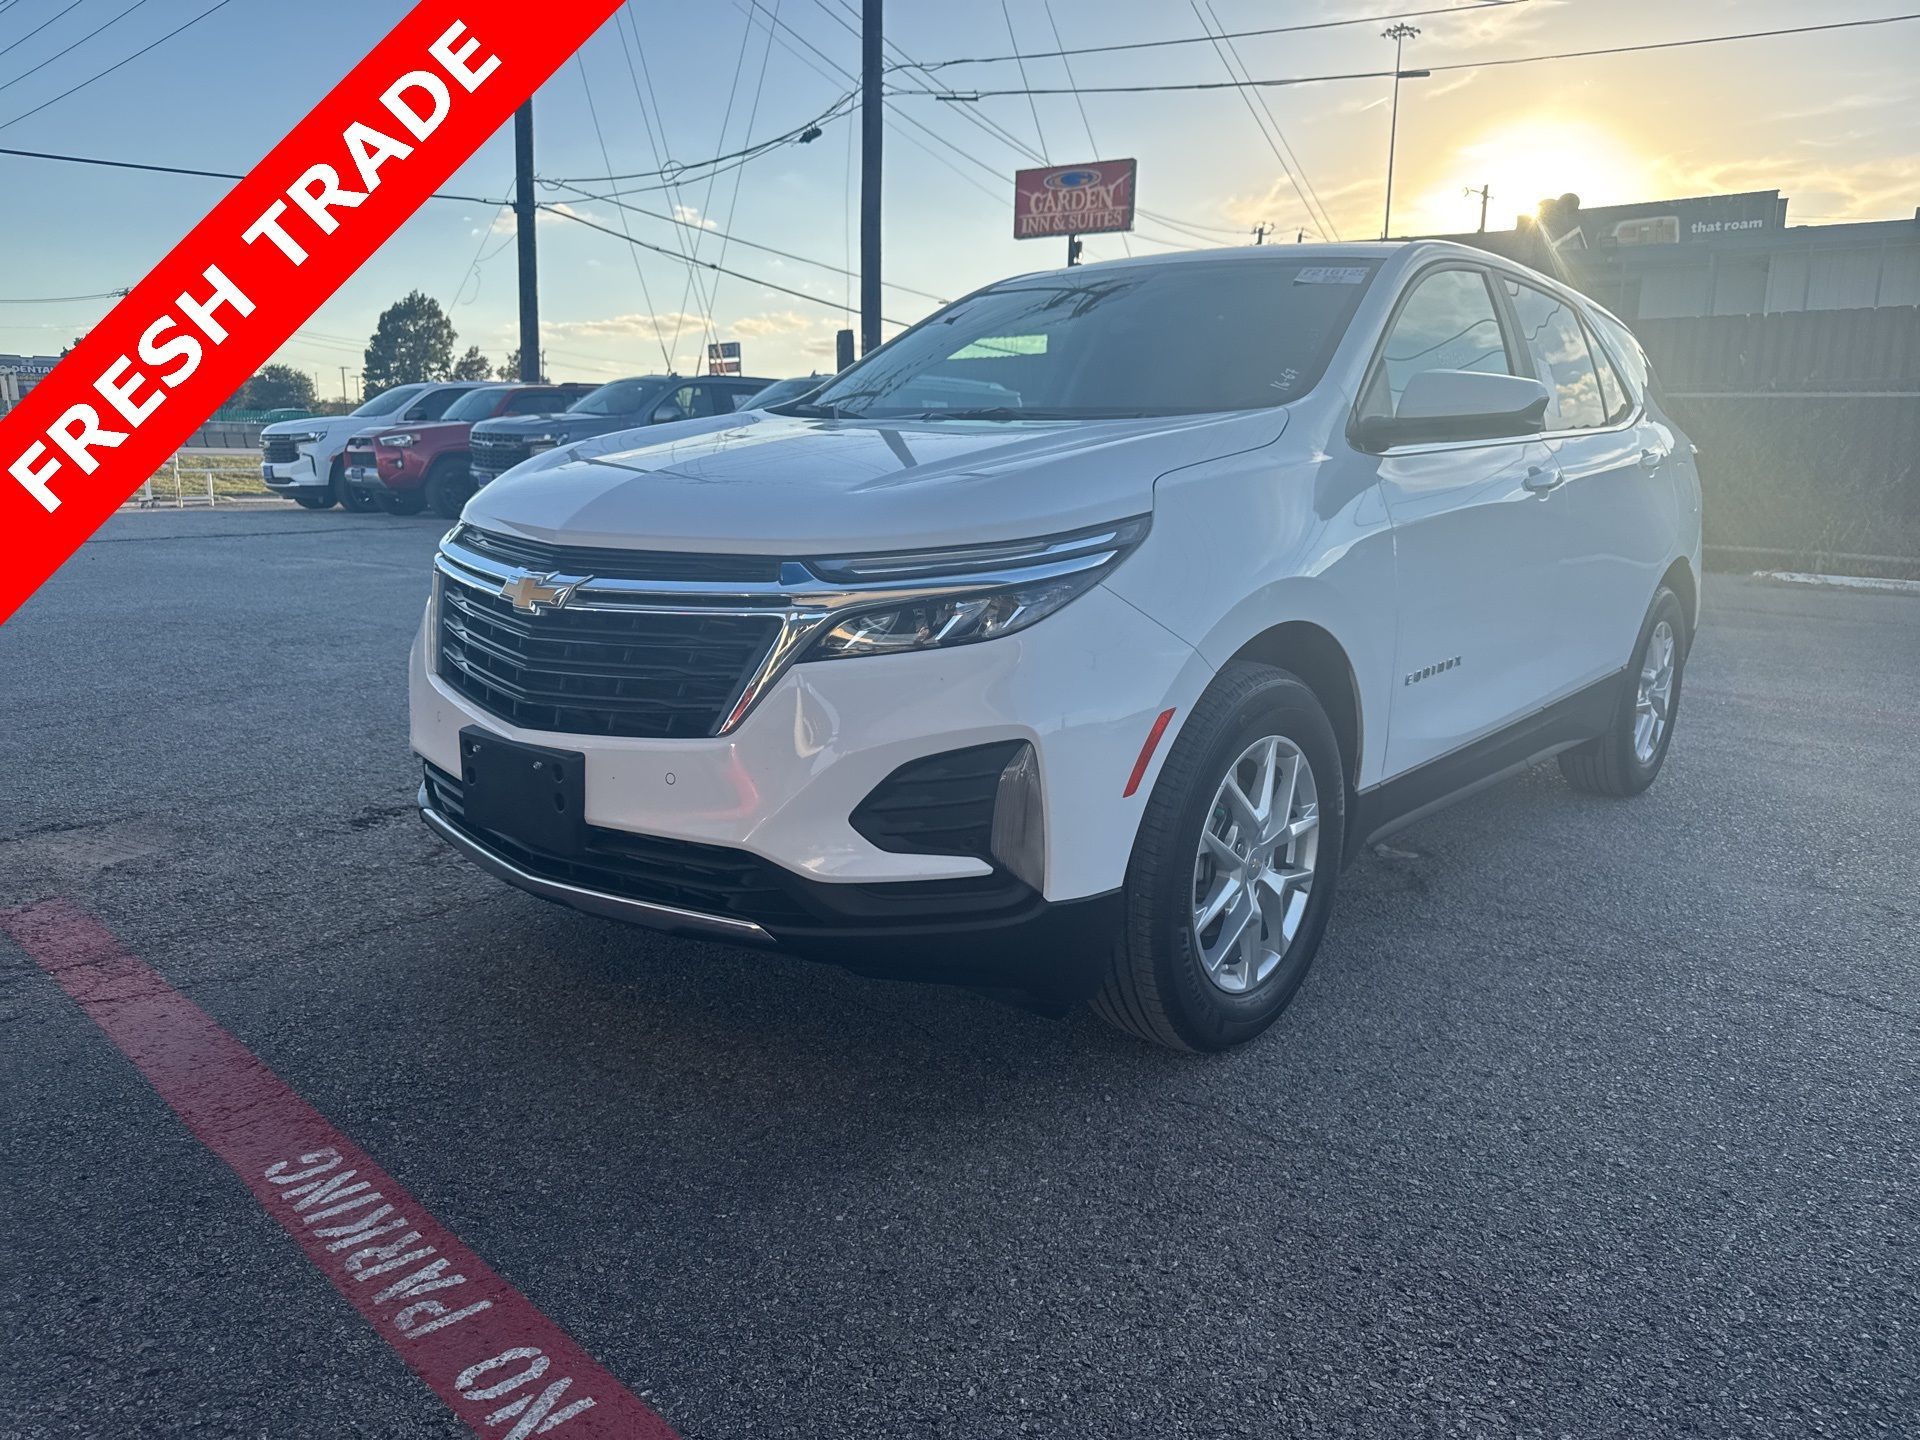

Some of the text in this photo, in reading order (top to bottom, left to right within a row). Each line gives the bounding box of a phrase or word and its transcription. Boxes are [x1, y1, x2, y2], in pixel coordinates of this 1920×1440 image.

[1029, 184, 1116, 214] GARDEN
[1021, 210, 1123, 234] INN & SUITES
[1691, 220, 1763, 233] that roam
[264, 1147, 598, 1440] NO PARKING
